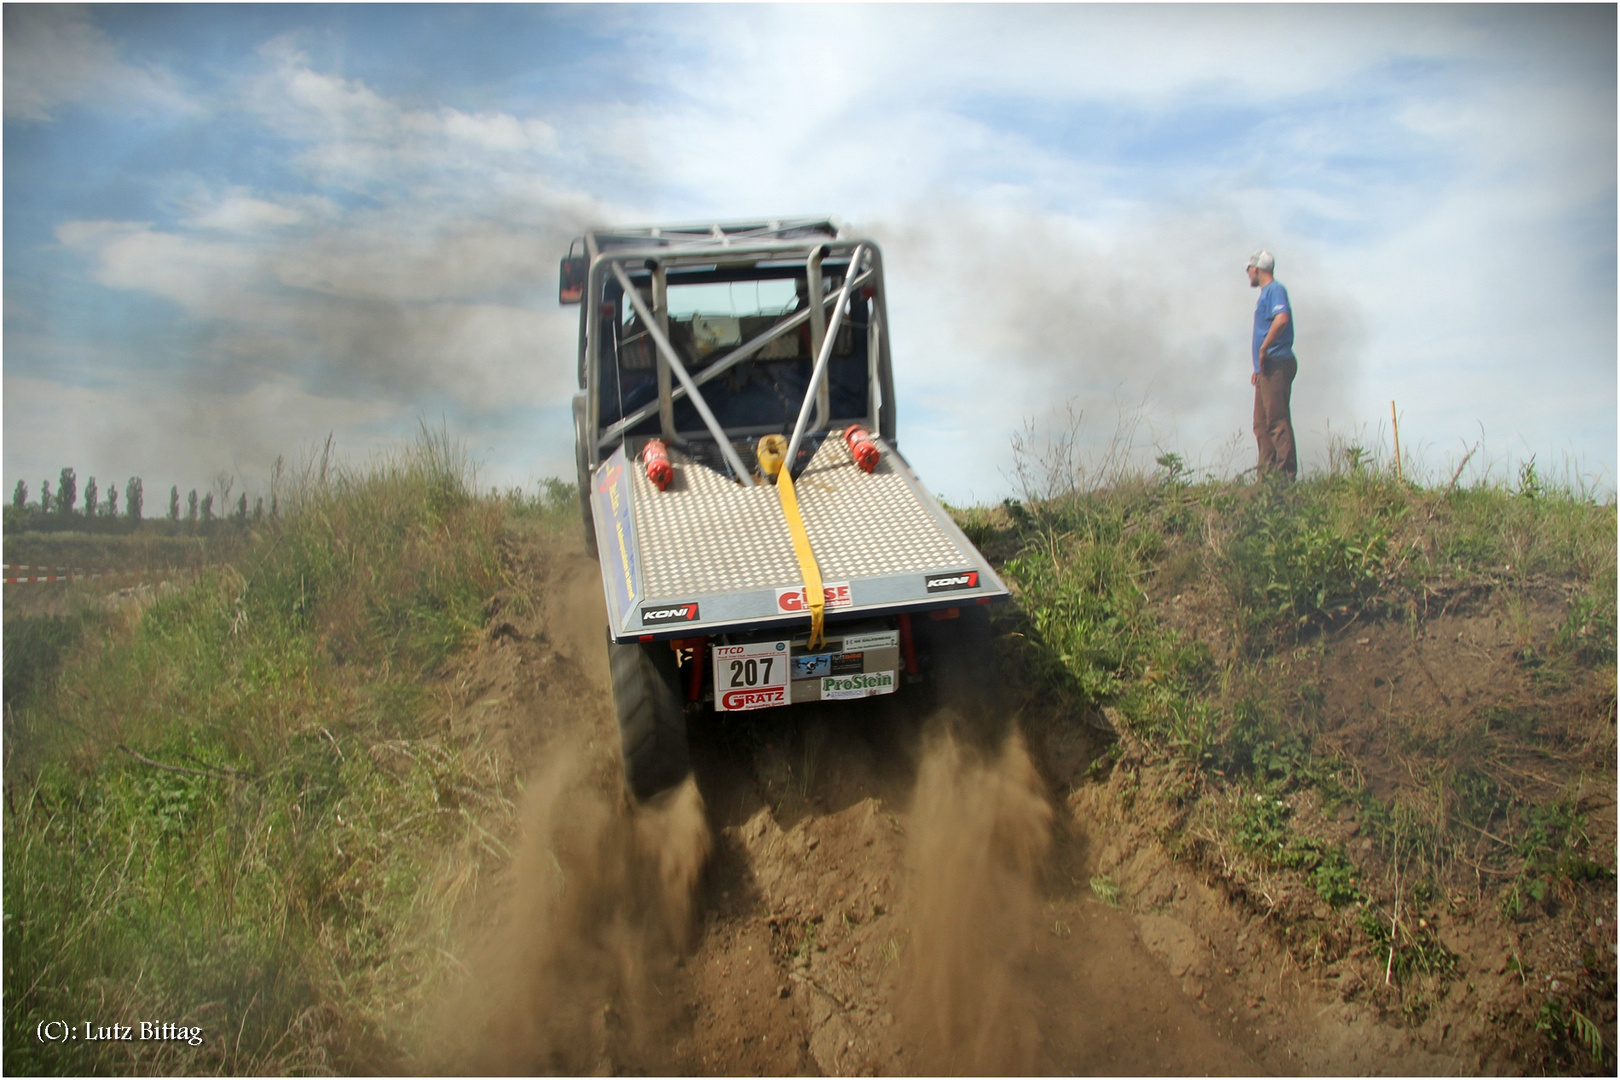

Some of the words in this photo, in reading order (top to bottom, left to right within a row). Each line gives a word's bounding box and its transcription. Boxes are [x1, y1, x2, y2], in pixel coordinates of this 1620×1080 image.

[927, 576, 971, 588] KONI
[643, 608, 688, 620] KONI
[717, 646, 744, 656] TTCD
[730, 658, 774, 687] 207
[823, 672, 892, 691] ProStein
